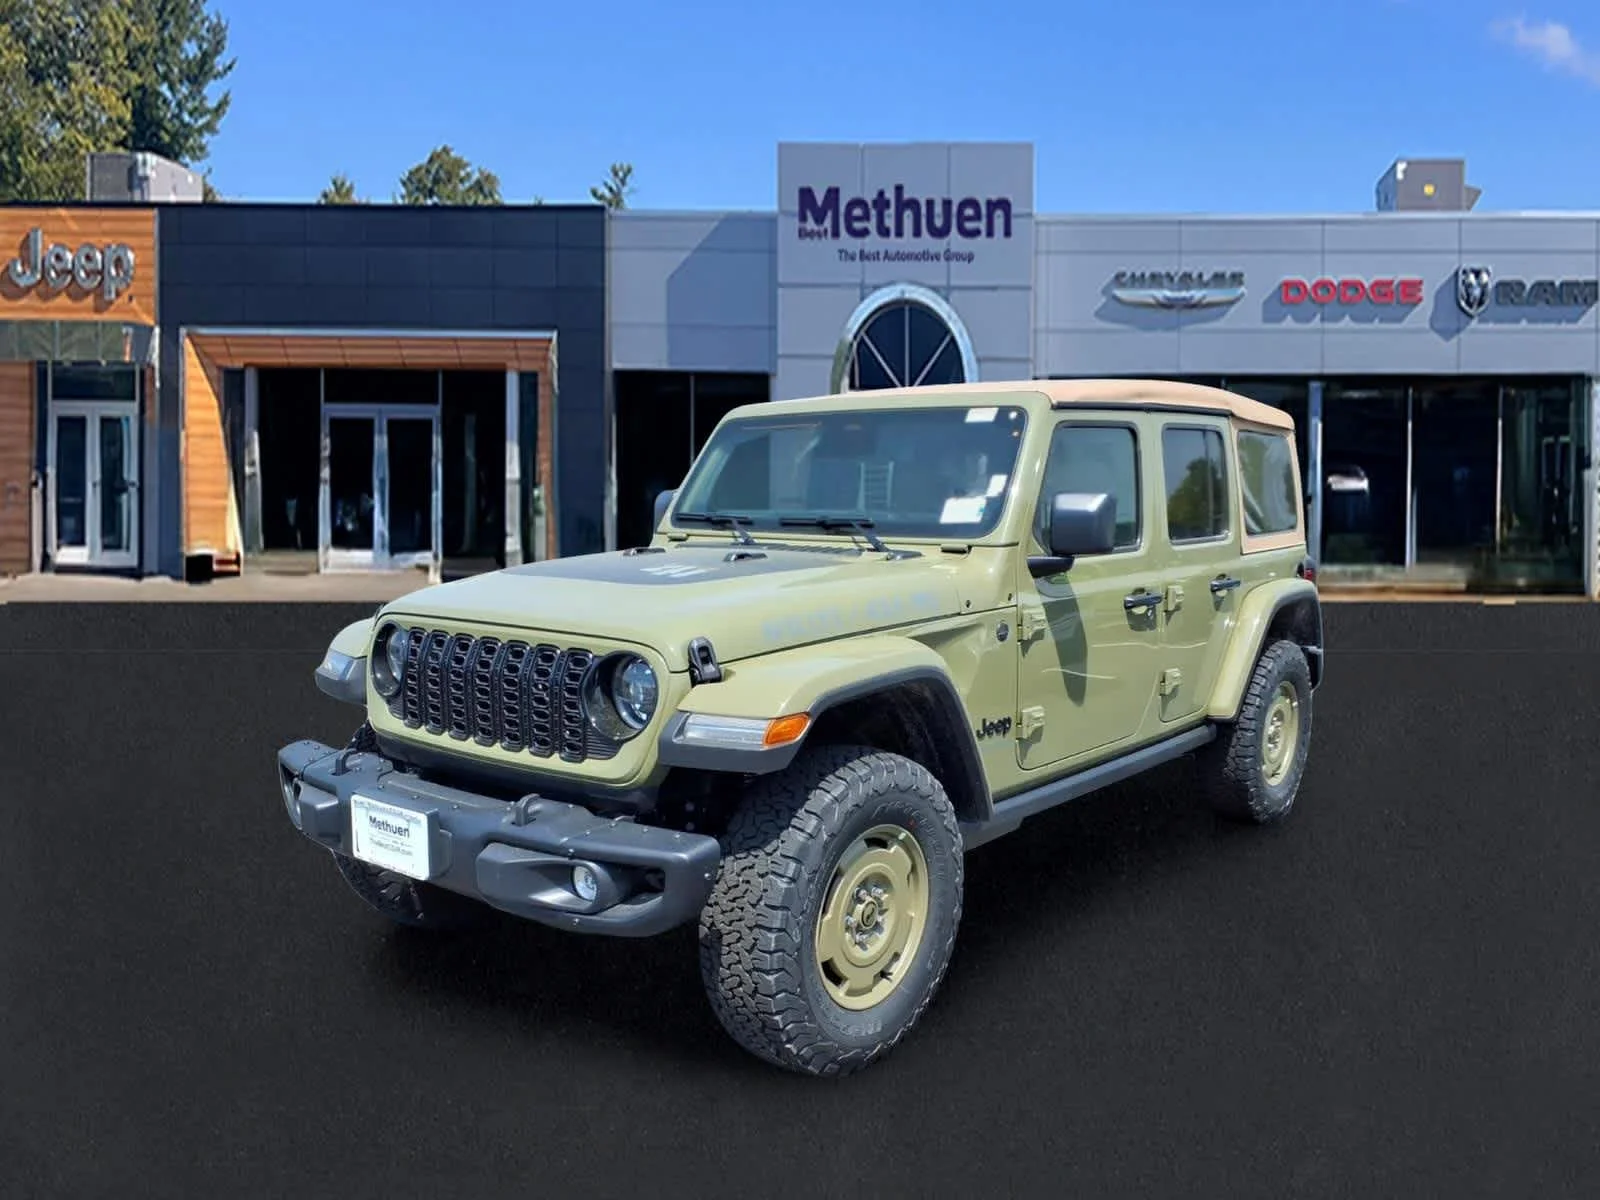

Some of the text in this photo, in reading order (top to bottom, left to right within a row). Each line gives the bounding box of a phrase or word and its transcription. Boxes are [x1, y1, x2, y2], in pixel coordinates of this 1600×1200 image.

[798, 184, 1012, 239] Methuen
[8, 228, 134, 300] Jeep
[838, 247, 975, 264] The Best Automotive Group
[1113, 271, 1245, 288] CHRYSLER
[1281, 279, 1424, 305] DODGE
[1495, 280, 1598, 306] RAM
[976, 716, 1012, 740] Jeep
[368, 815, 410, 838] Methuen
